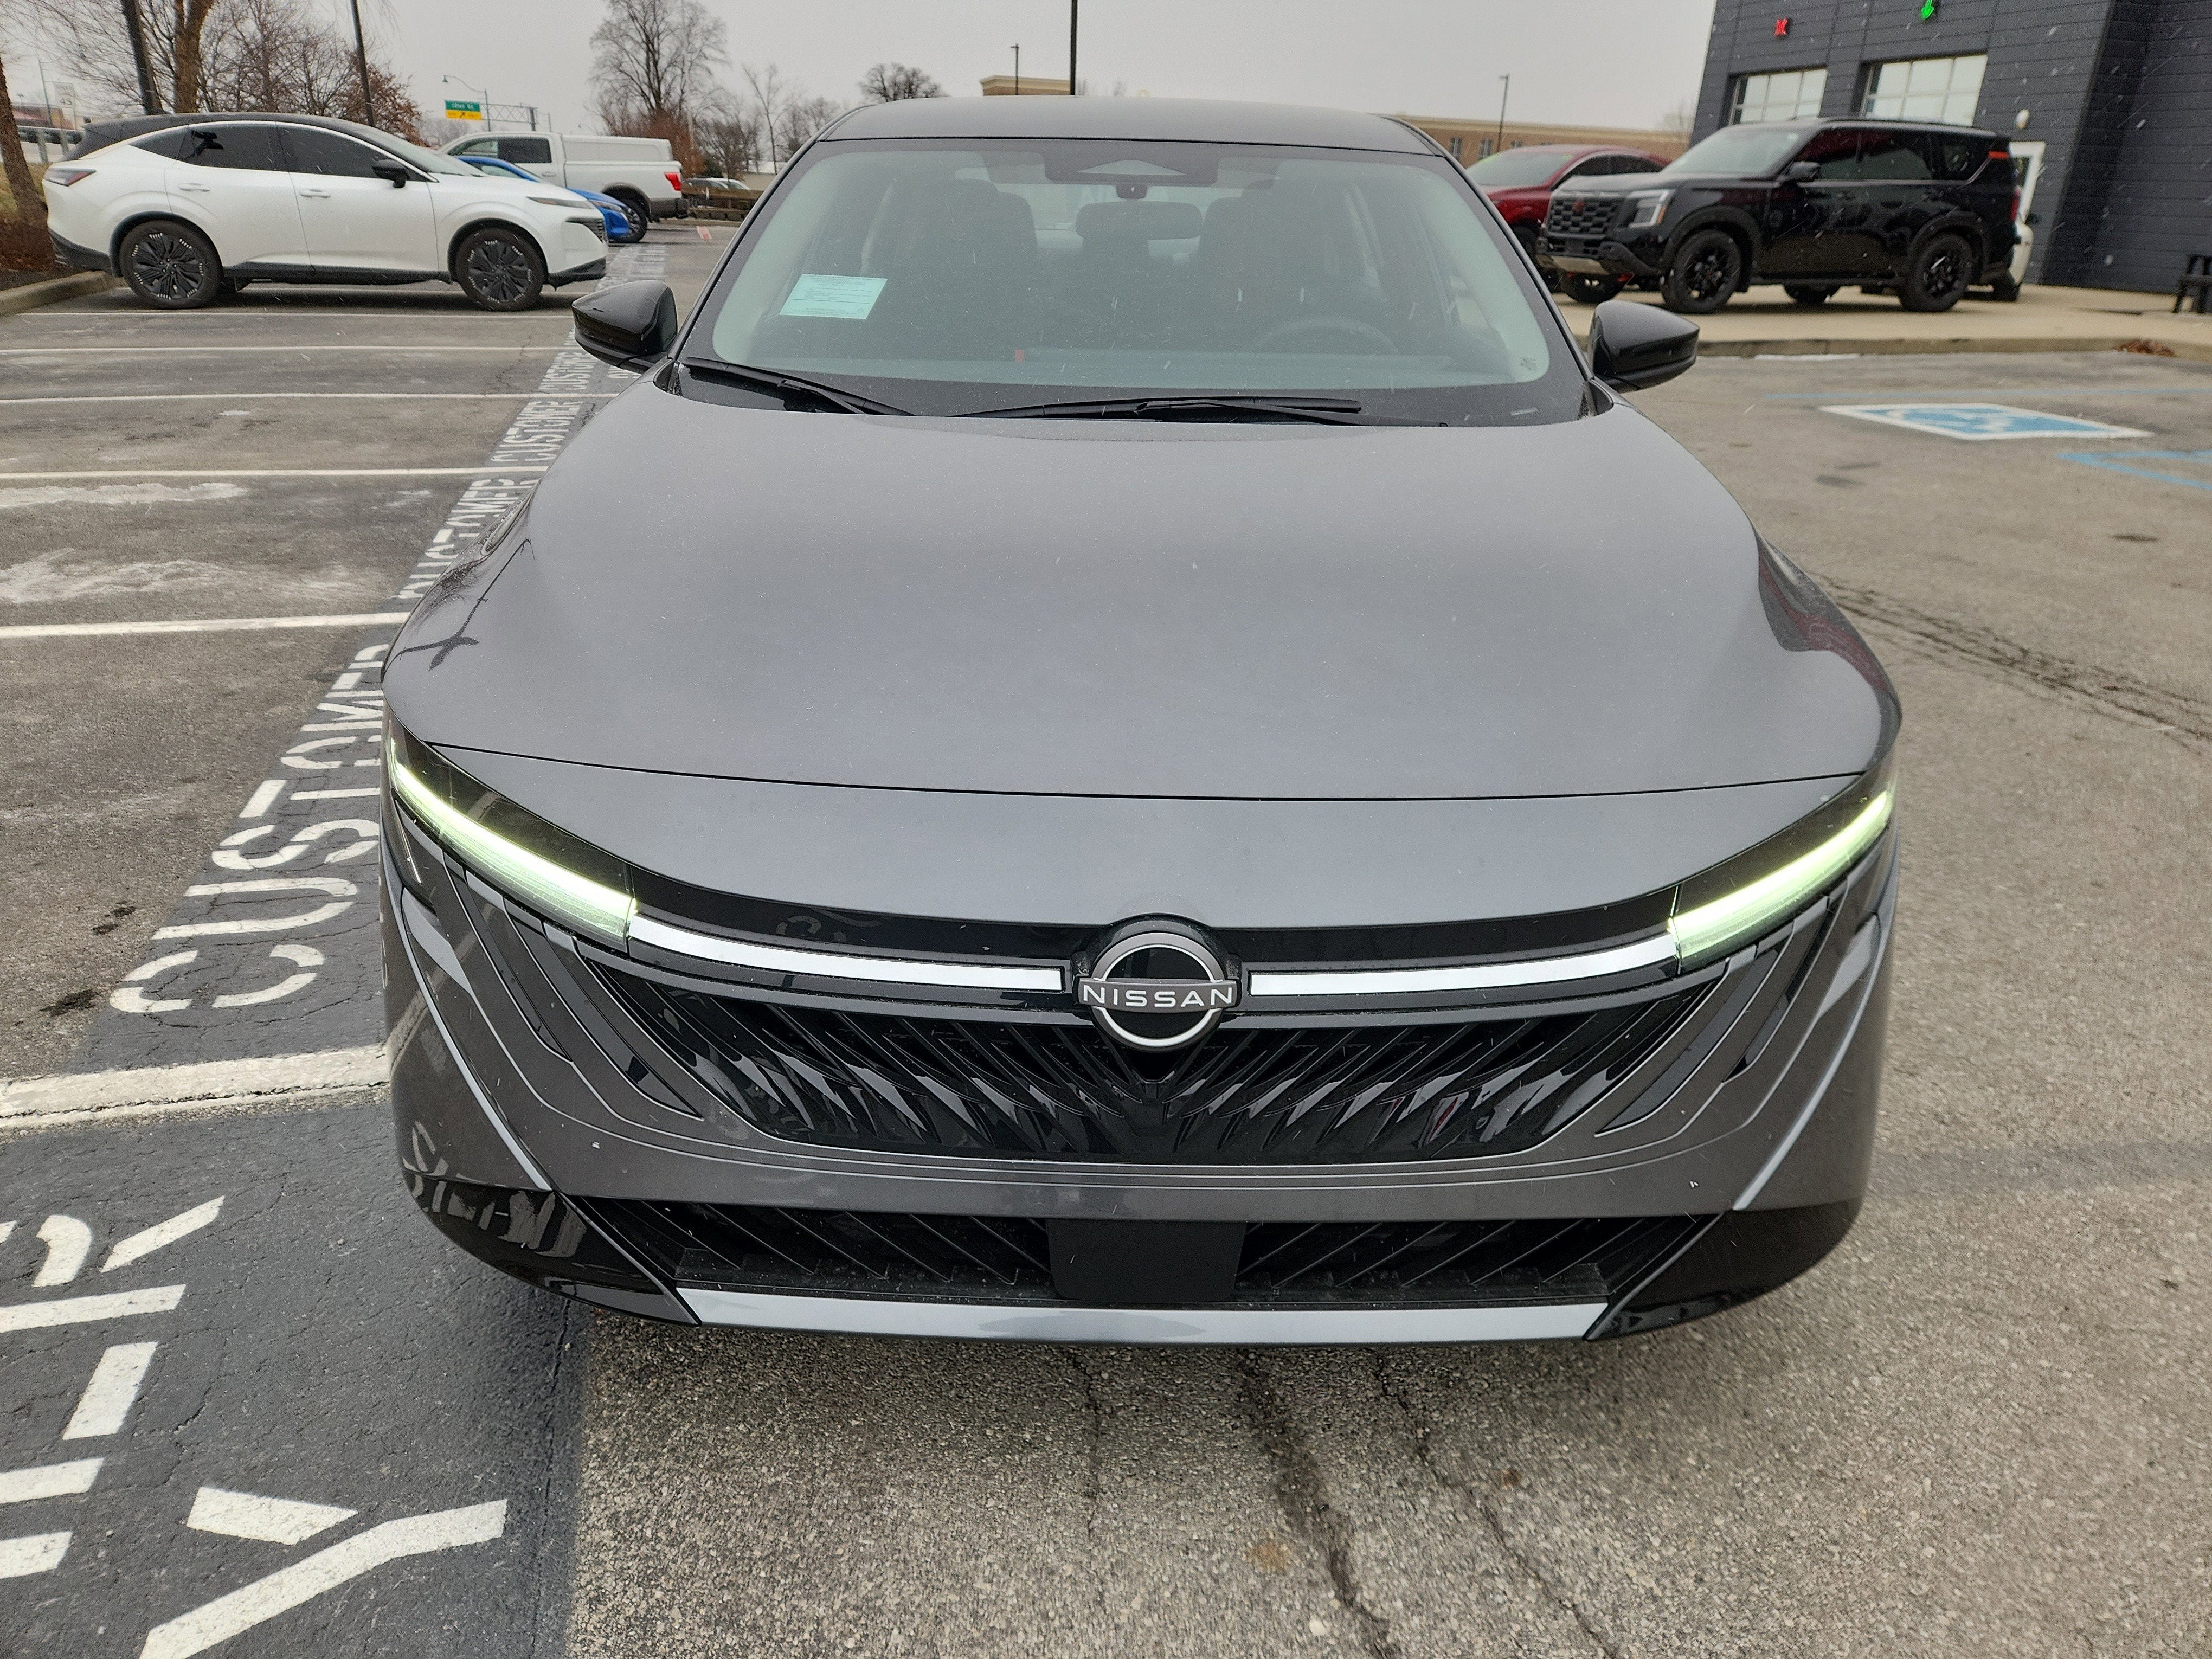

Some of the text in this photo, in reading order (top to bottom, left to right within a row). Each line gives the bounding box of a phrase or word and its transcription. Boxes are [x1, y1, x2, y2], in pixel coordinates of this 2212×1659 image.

[491, 401, 583, 461] CUSTOMER
[110, 644, 389, 1013] CUSTOM
[1082, 984, 1233, 1008] NISSAN
